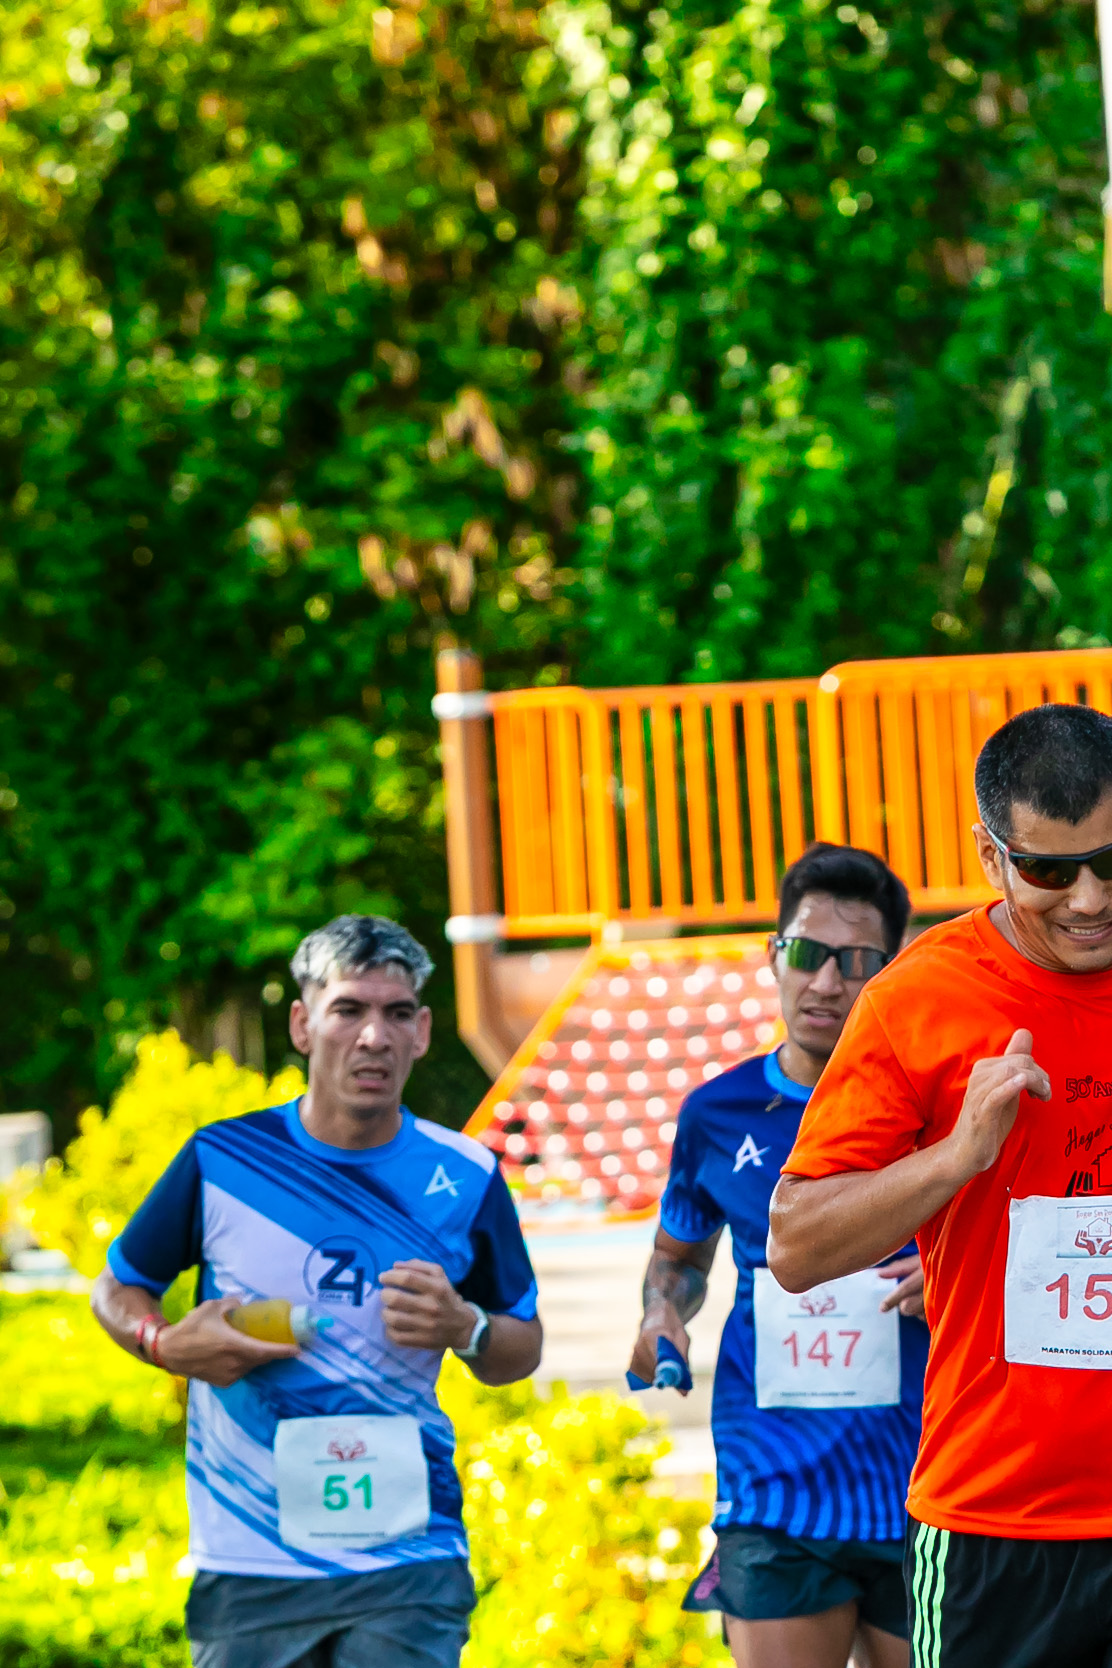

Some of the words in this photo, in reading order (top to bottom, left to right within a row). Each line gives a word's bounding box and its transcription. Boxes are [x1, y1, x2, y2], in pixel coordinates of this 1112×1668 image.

[783, 1331, 862, 1368] 147
[1041, 1347, 1080, 1355] MARATON
[323, 1474, 373, 1511] 51
